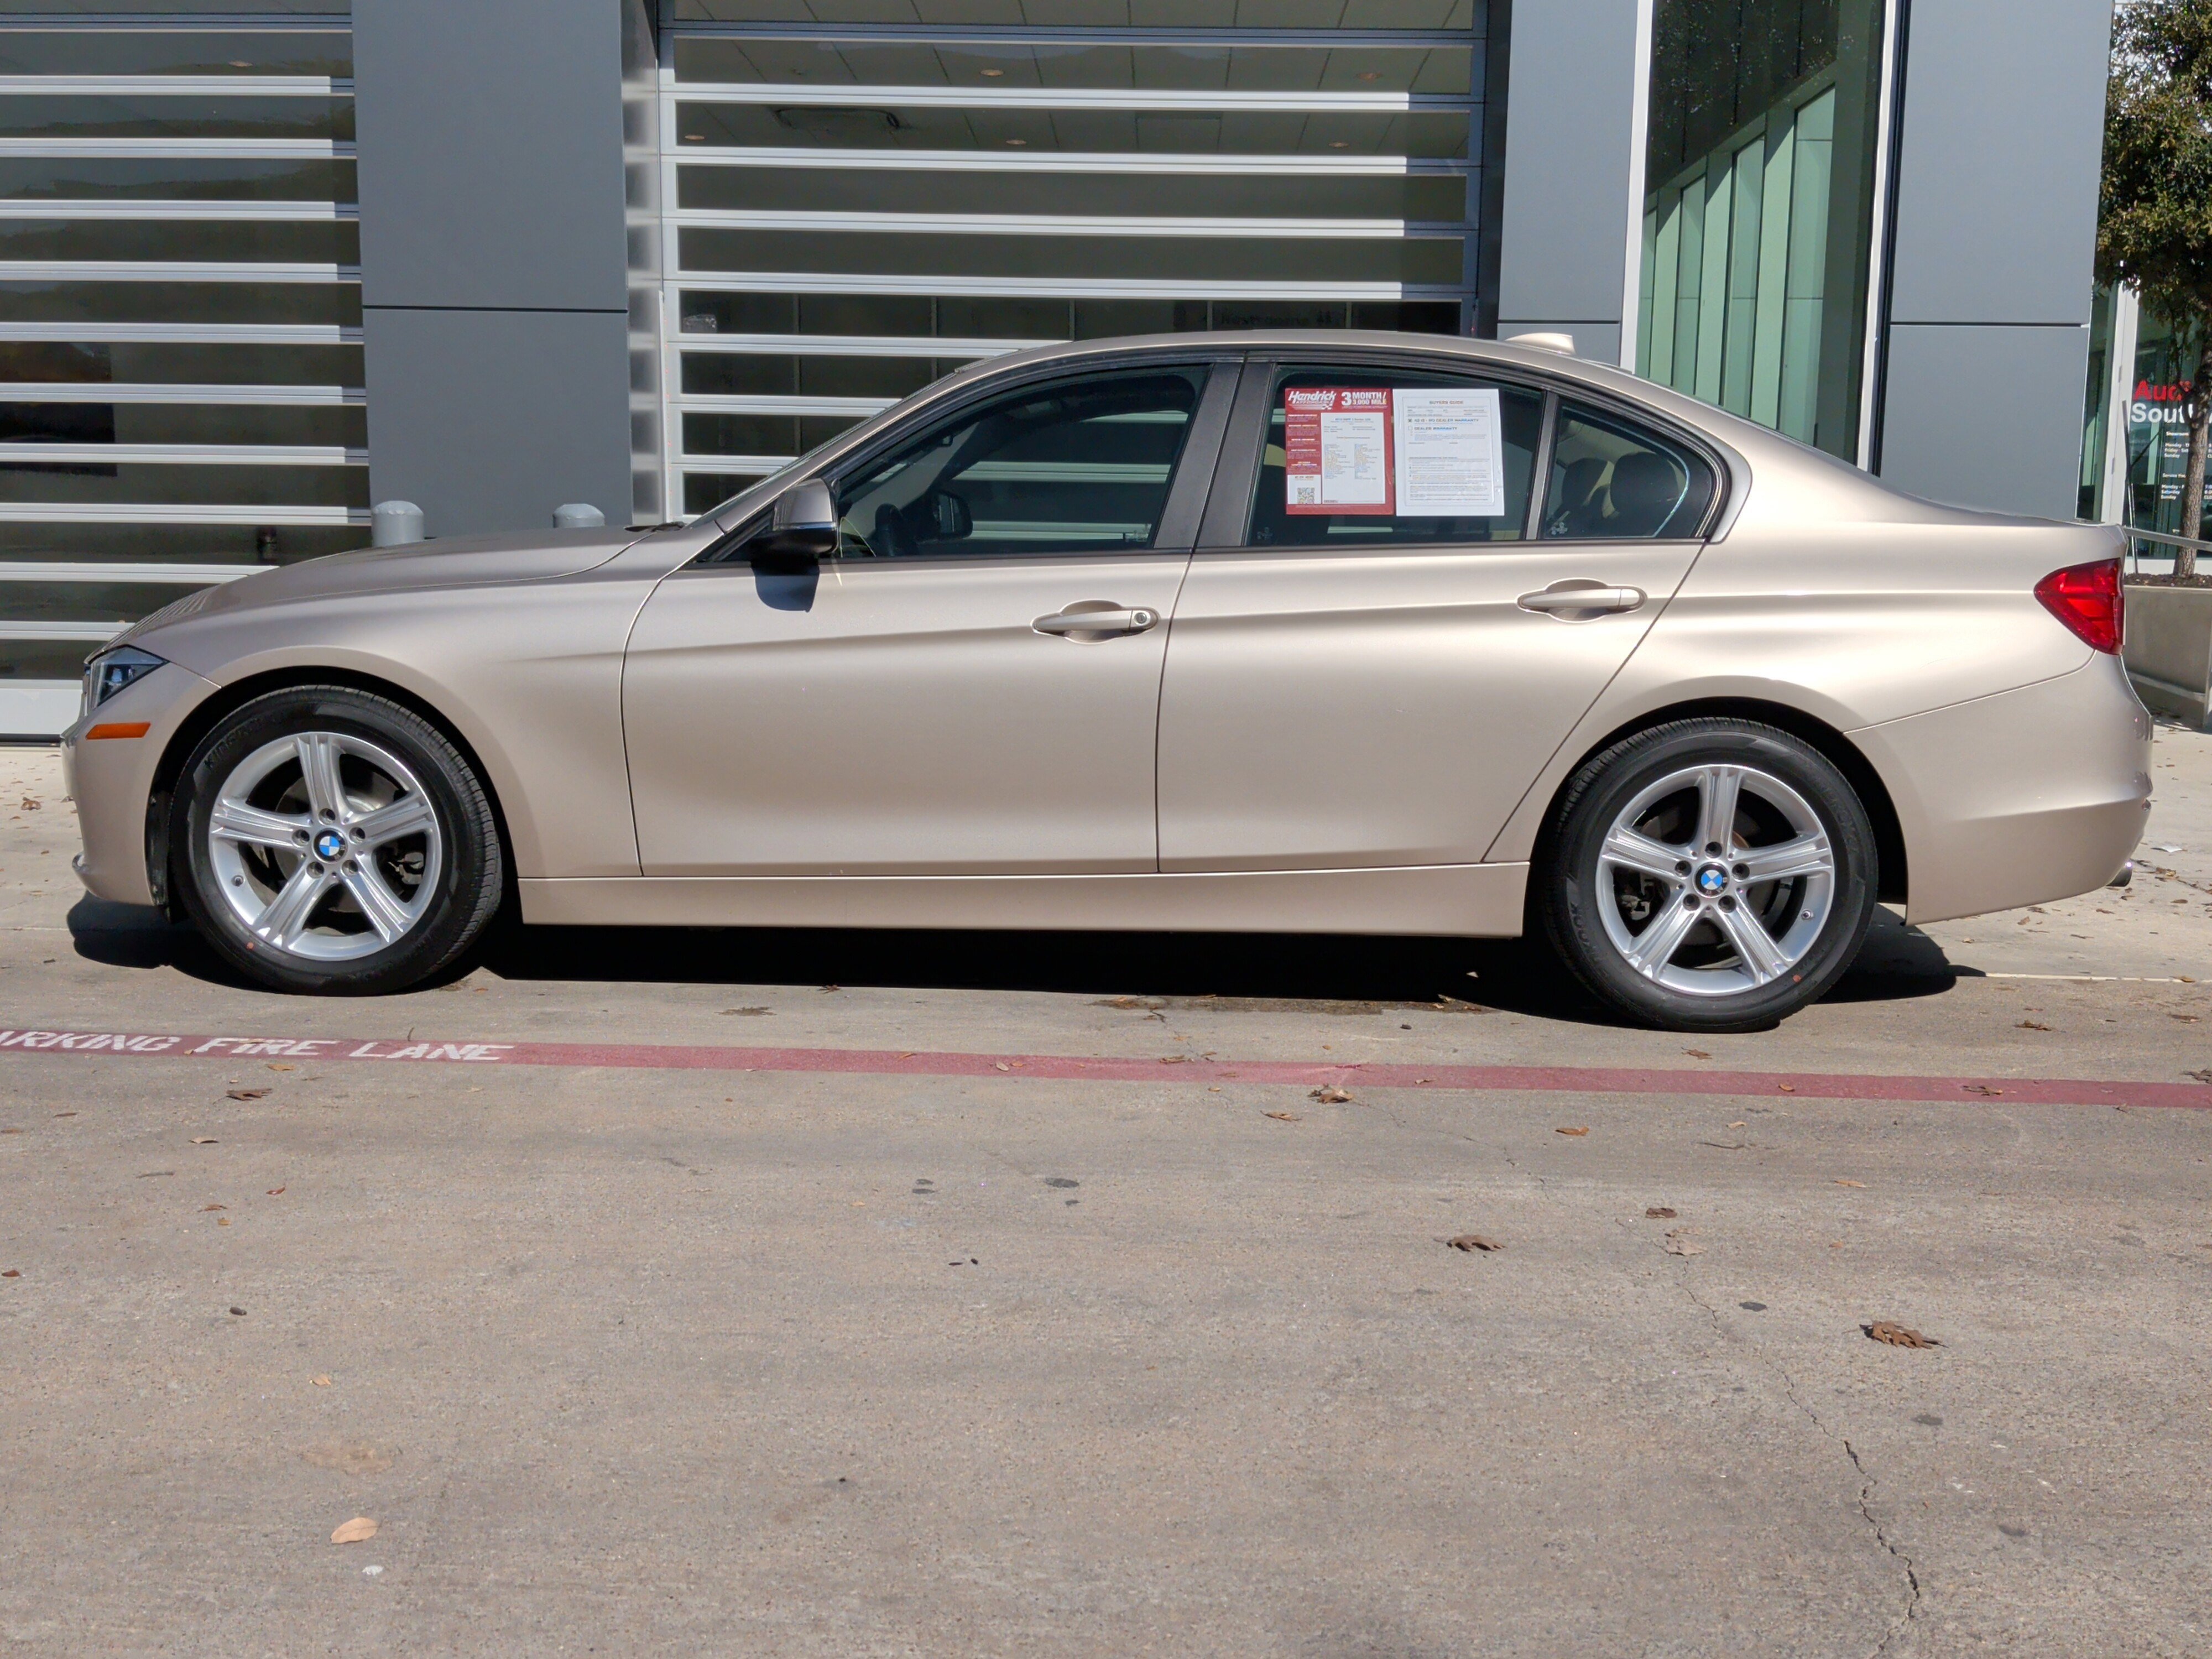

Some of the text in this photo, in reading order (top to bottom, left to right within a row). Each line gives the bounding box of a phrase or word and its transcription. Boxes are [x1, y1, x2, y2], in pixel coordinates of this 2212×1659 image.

[1288, 390, 1337, 404] Hendrick
[1341, 392, 1352, 405] 3
[194, 1037, 341, 1056] FIRE
[348, 1042, 515, 1061] LANE
